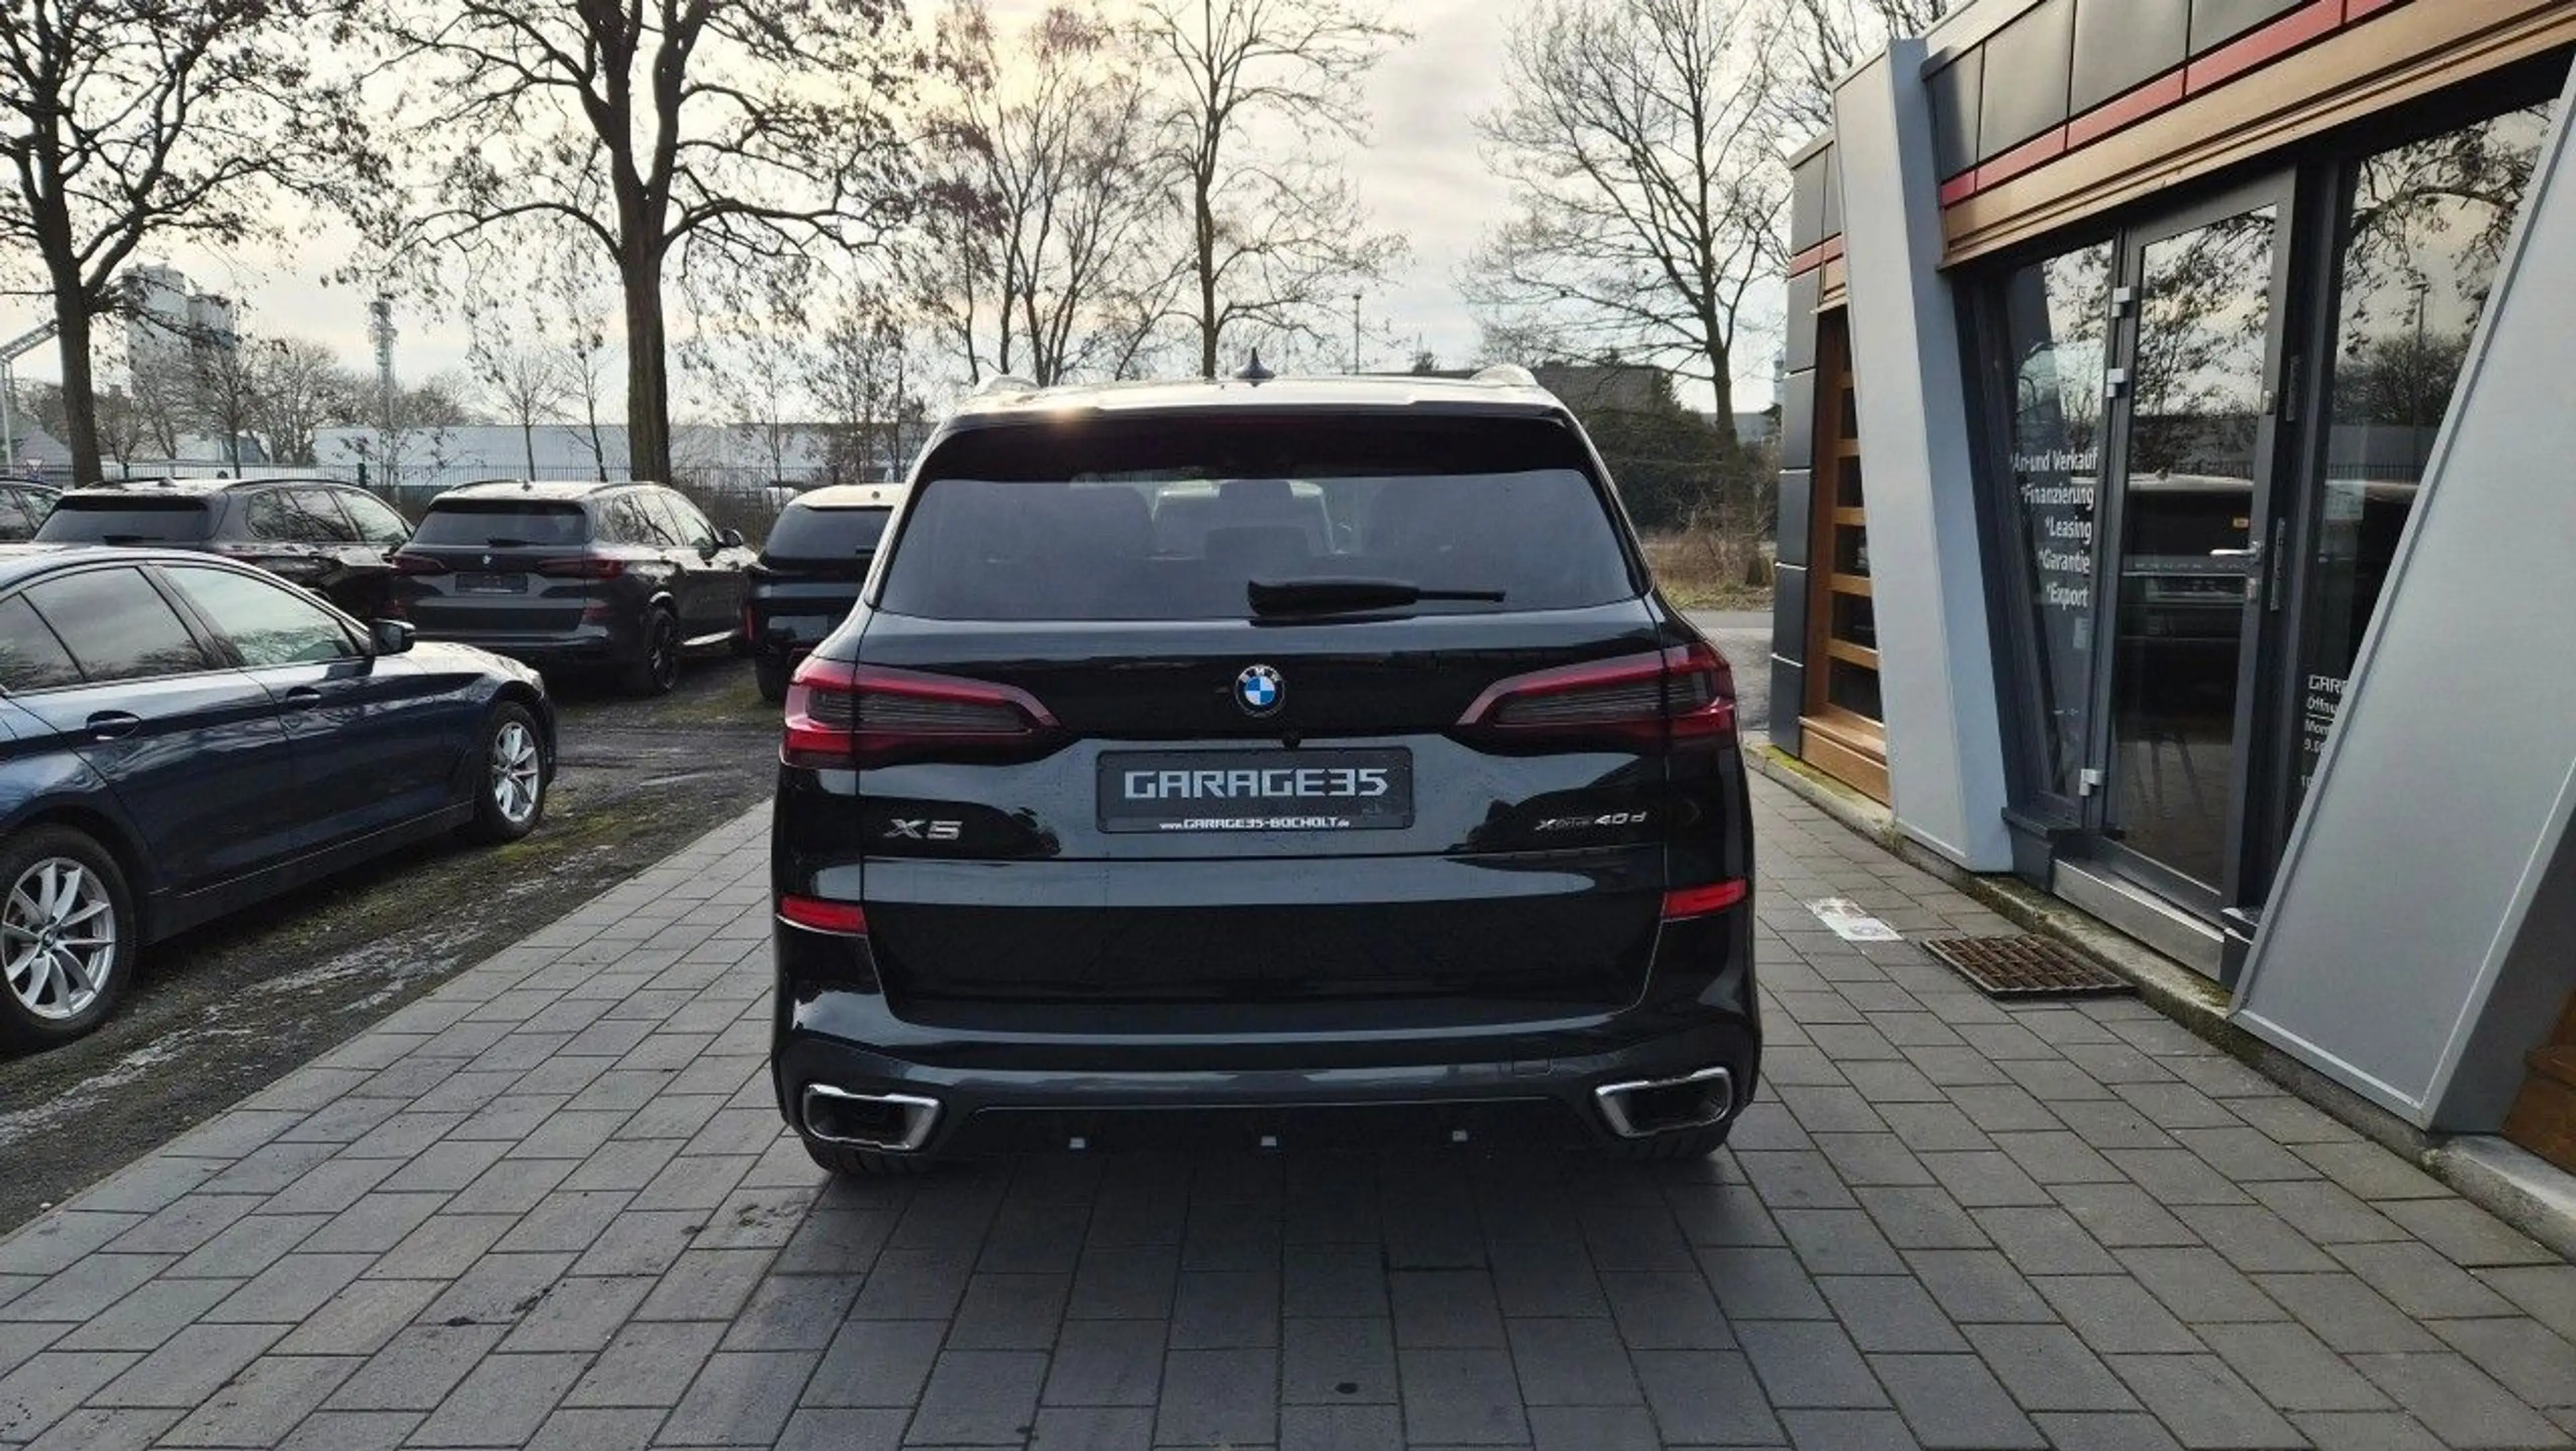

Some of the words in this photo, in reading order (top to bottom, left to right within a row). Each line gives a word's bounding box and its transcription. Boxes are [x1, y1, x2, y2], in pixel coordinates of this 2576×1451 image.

[2053, 446, 2098, 471] Verkauf
[1125, 768, 1389, 799] GARAGE35
[883, 818, 963, 840] X5
[1159, 816, 1350, 830] www.GARAGE35-BOCHOLT.de
